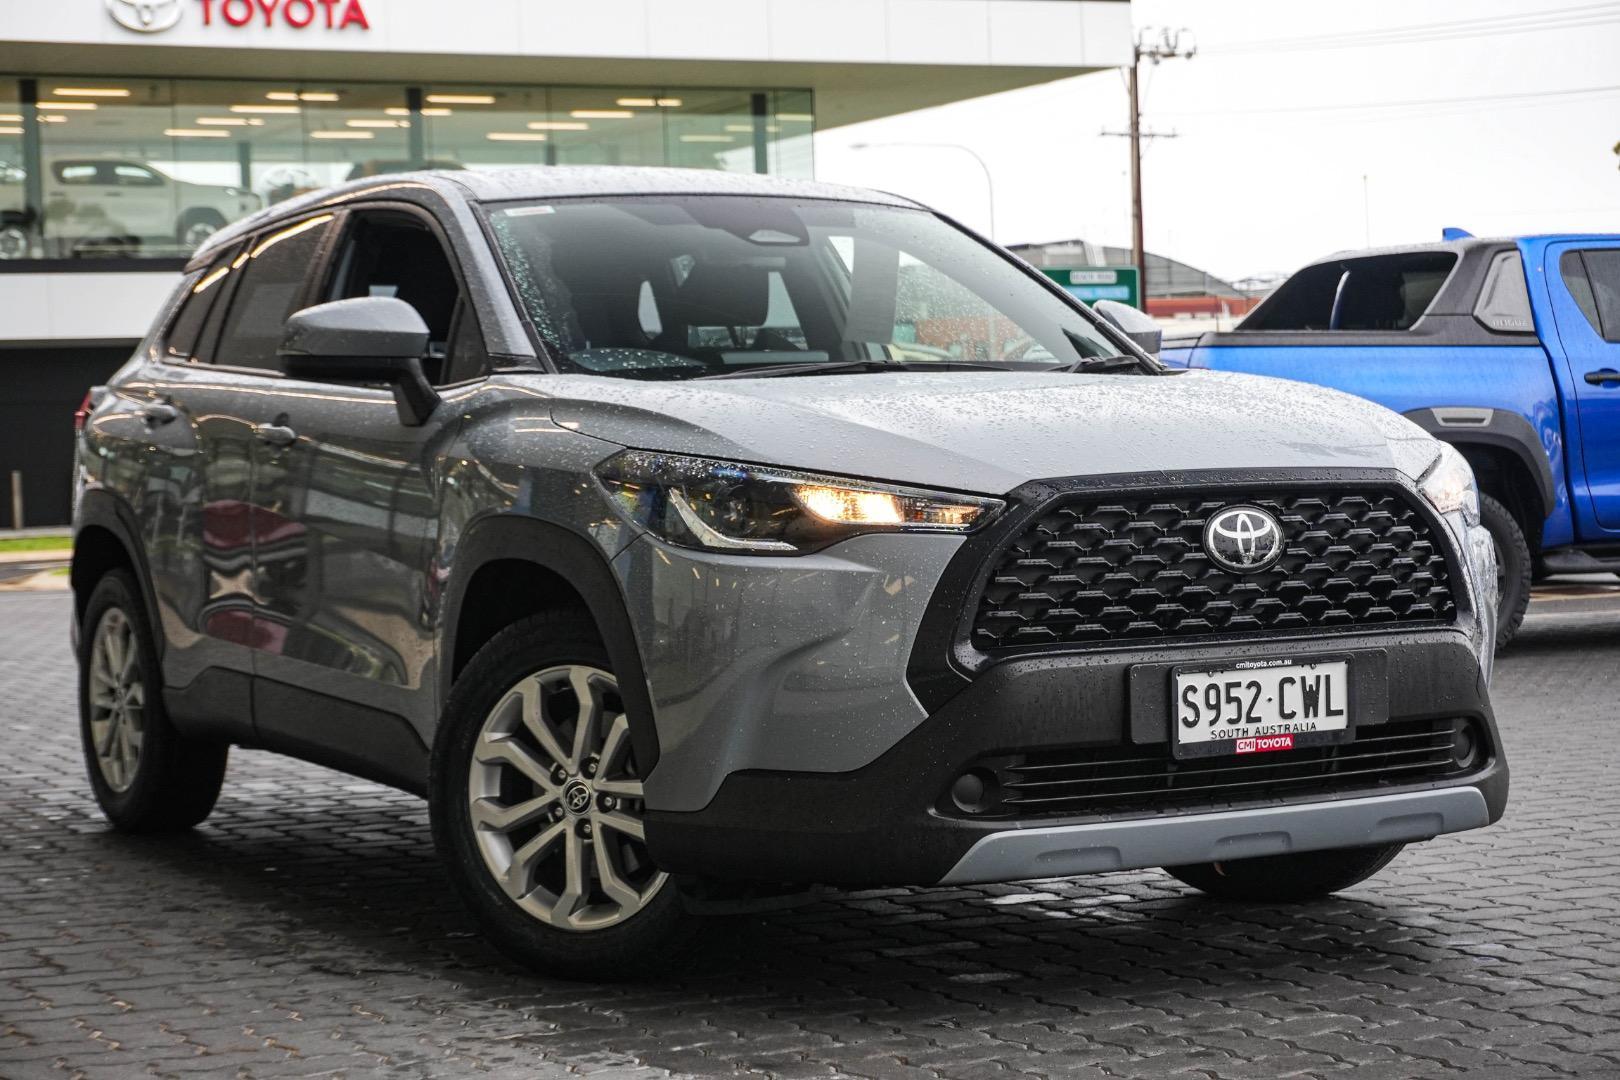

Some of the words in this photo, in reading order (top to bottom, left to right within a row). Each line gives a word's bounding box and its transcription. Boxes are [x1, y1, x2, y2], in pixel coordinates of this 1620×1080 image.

[195, 0, 370, 29] TOYOTA
[1235, 659, 1292, 669] cmitoyota.com.au
[1210, 728, 1249, 740] SOUTH
[1254, 722, 1317, 736] AUSTRALIA
[1237, 741, 1255, 751] CMI
[1257, 737, 1292, 749] TOYOTA
